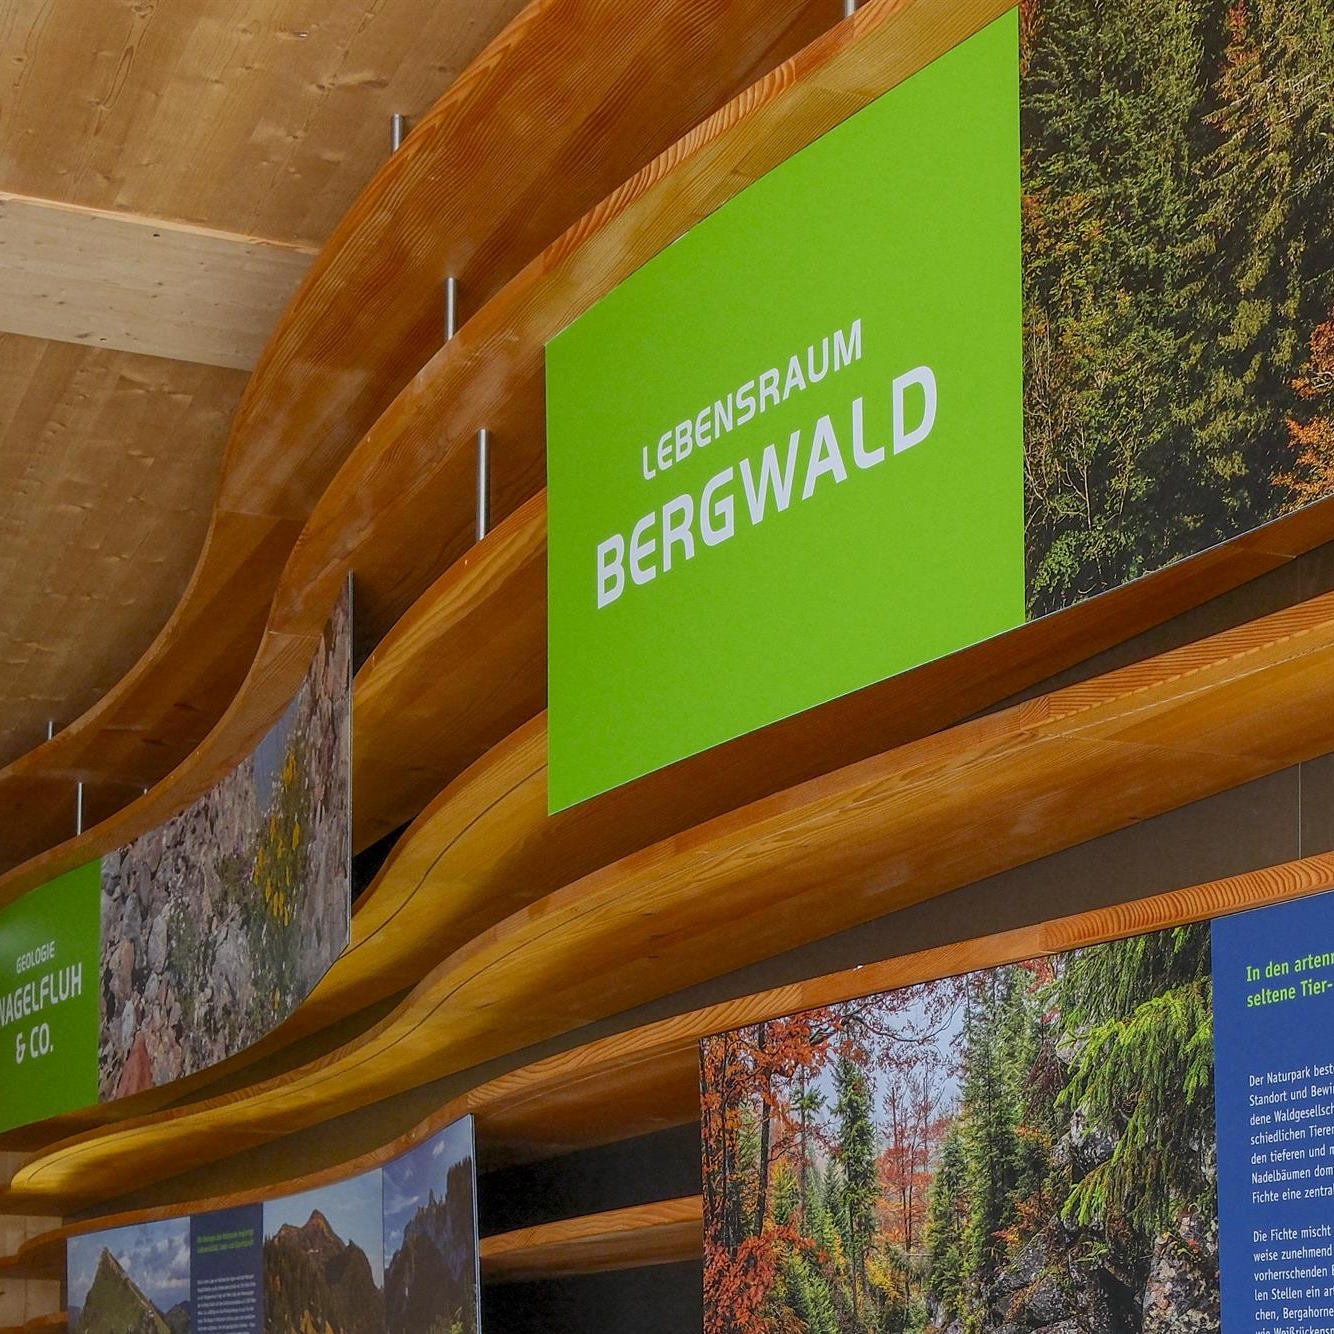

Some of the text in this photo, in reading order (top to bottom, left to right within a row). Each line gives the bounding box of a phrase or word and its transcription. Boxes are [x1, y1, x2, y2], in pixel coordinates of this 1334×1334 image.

[642, 318, 862, 481] LEBENSRAUM
[597, 365, 938, 609] BERGWALD
[16, 940, 56, 974] GEOLOGIE
[1246, 965, 1260, 982] In
[1265, 961, 1289, 978] den
[1247, 987, 1296, 1007] seltene
[1300, 978, 1333, 996] Tier-
[16, 1022, 54, 1064] & CO.
[1249, 1075, 1264, 1087] Der
[1266, 1066, 1310, 1083] Naturpark
[1249, 1090, 1287, 1106] Standort
[1290, 1086, 1307, 1100] und
[1249, 1113, 1271, 1125] dene
[1250, 1128, 1305, 1145] schiedlichen
[1251, 1152, 1267, 1164] den
[1270, 1148, 1305, 1162] tieferen
[1308, 1143, 1326, 1157] und
[1251, 1169, 1311, 1183] Nadelbäumen
[1252, 1190, 1279, 1203] Fichte
[1282, 1188, 1301, 1200] eine
